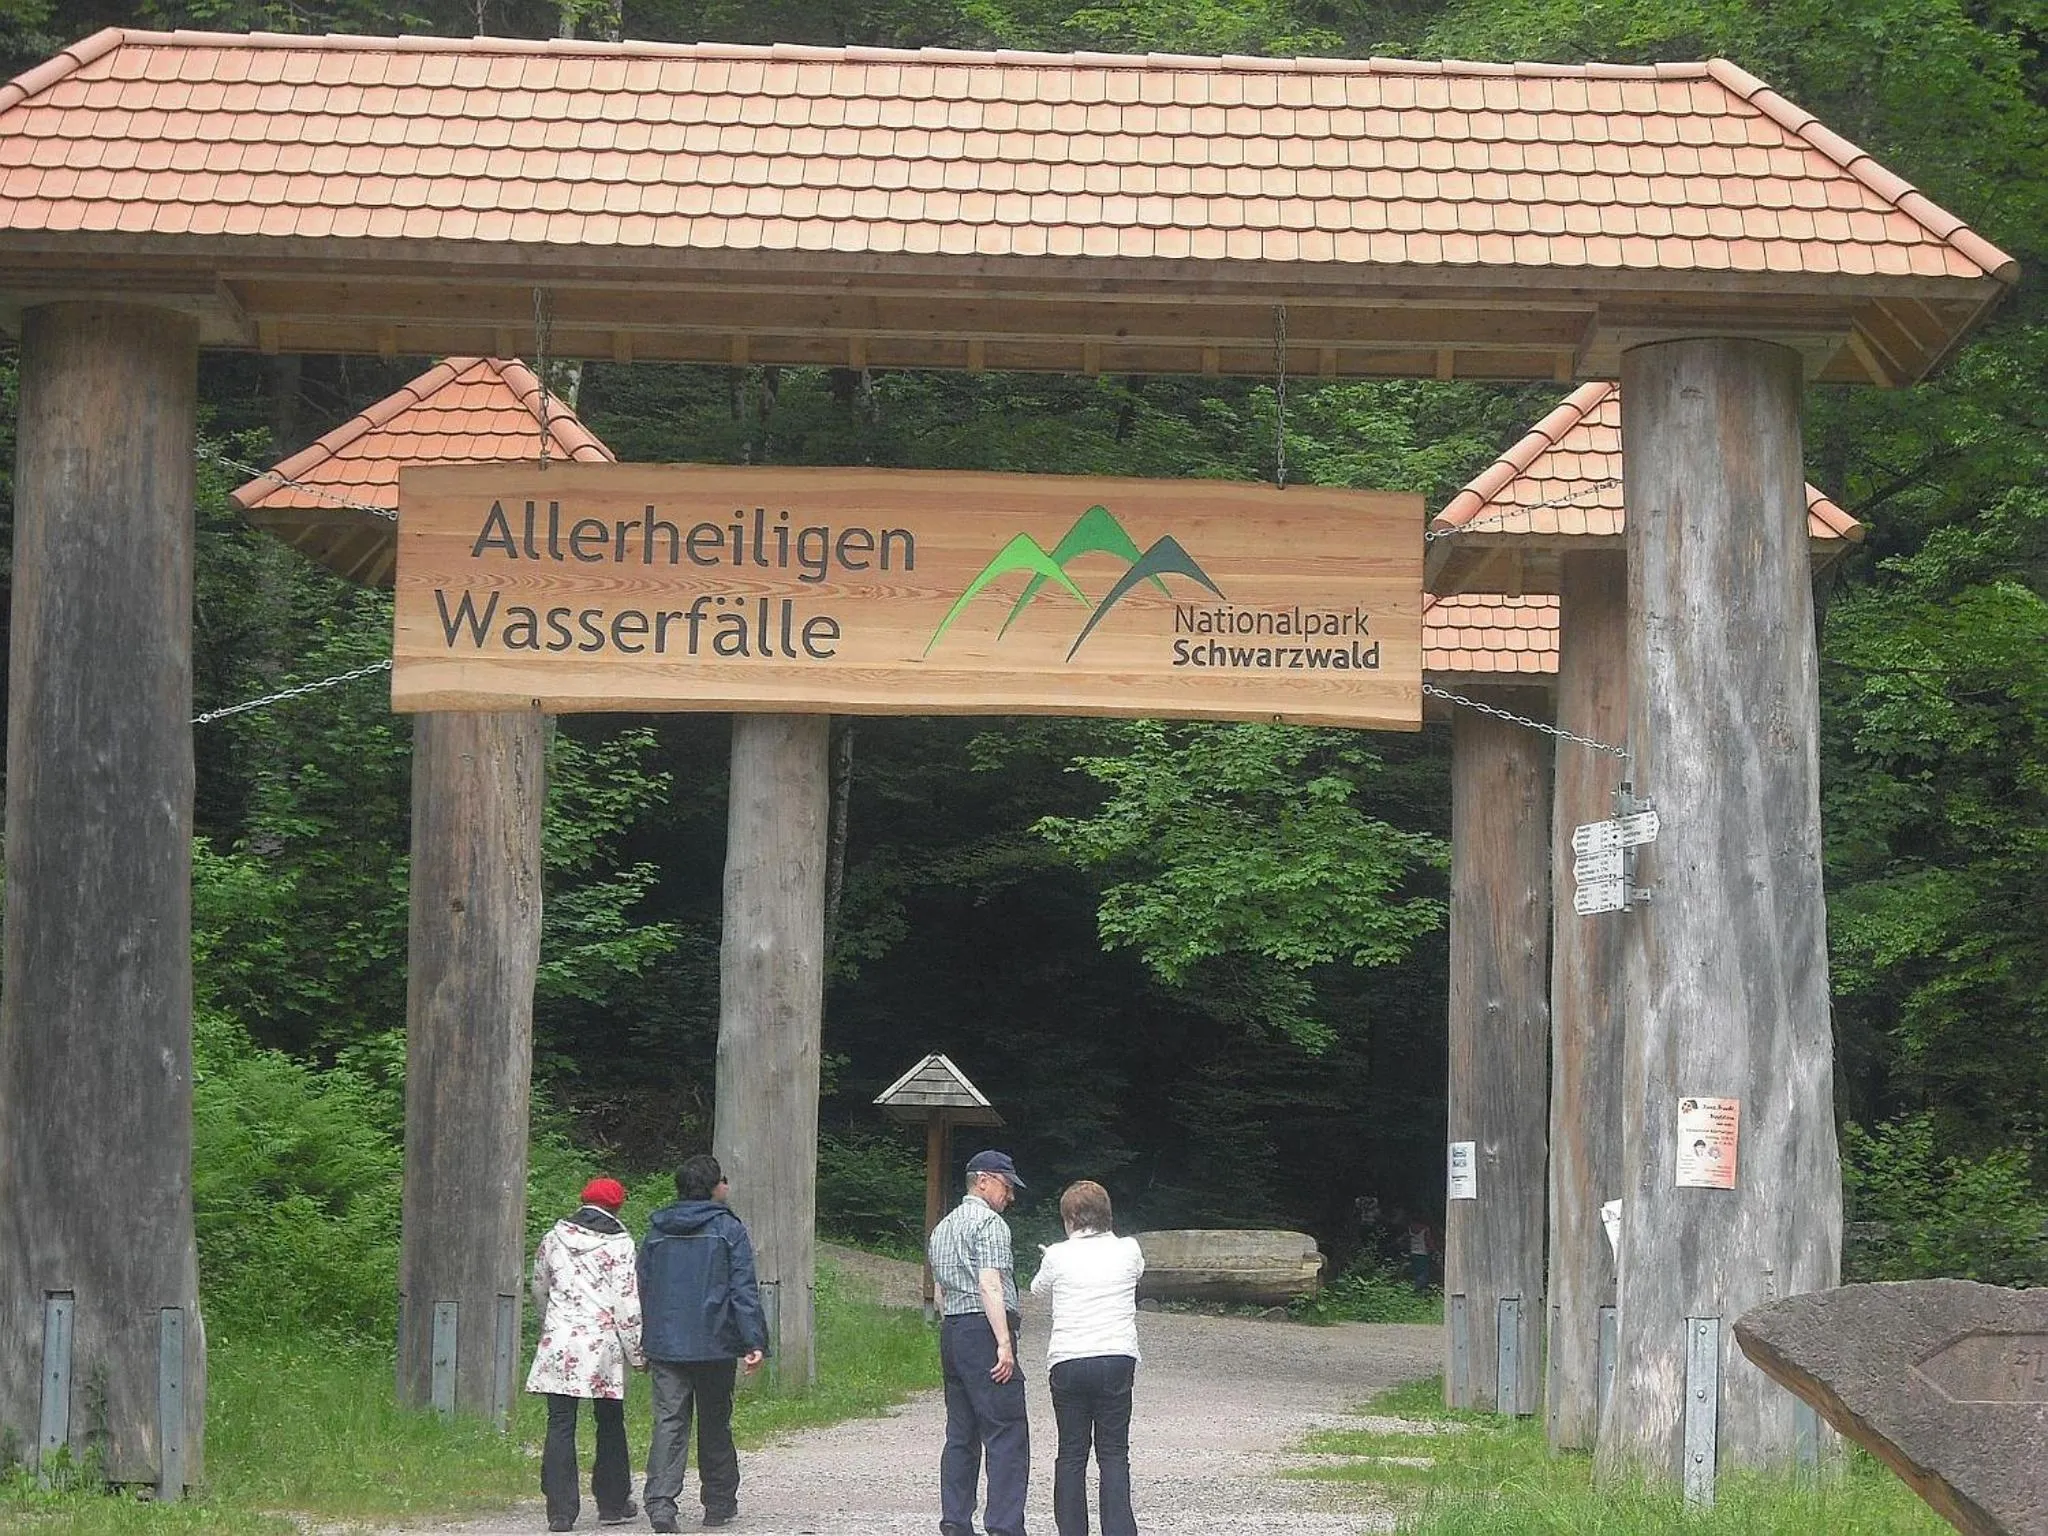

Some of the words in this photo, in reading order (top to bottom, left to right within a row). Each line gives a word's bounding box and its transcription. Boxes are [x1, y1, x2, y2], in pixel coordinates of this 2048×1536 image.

[472, 499, 916, 583] Allerheiligen
[434, 588, 841, 659] Wasserfälle
[1175, 605, 1369, 642] Nationalpark
[1172, 639, 1380, 669] Schwarzwald
